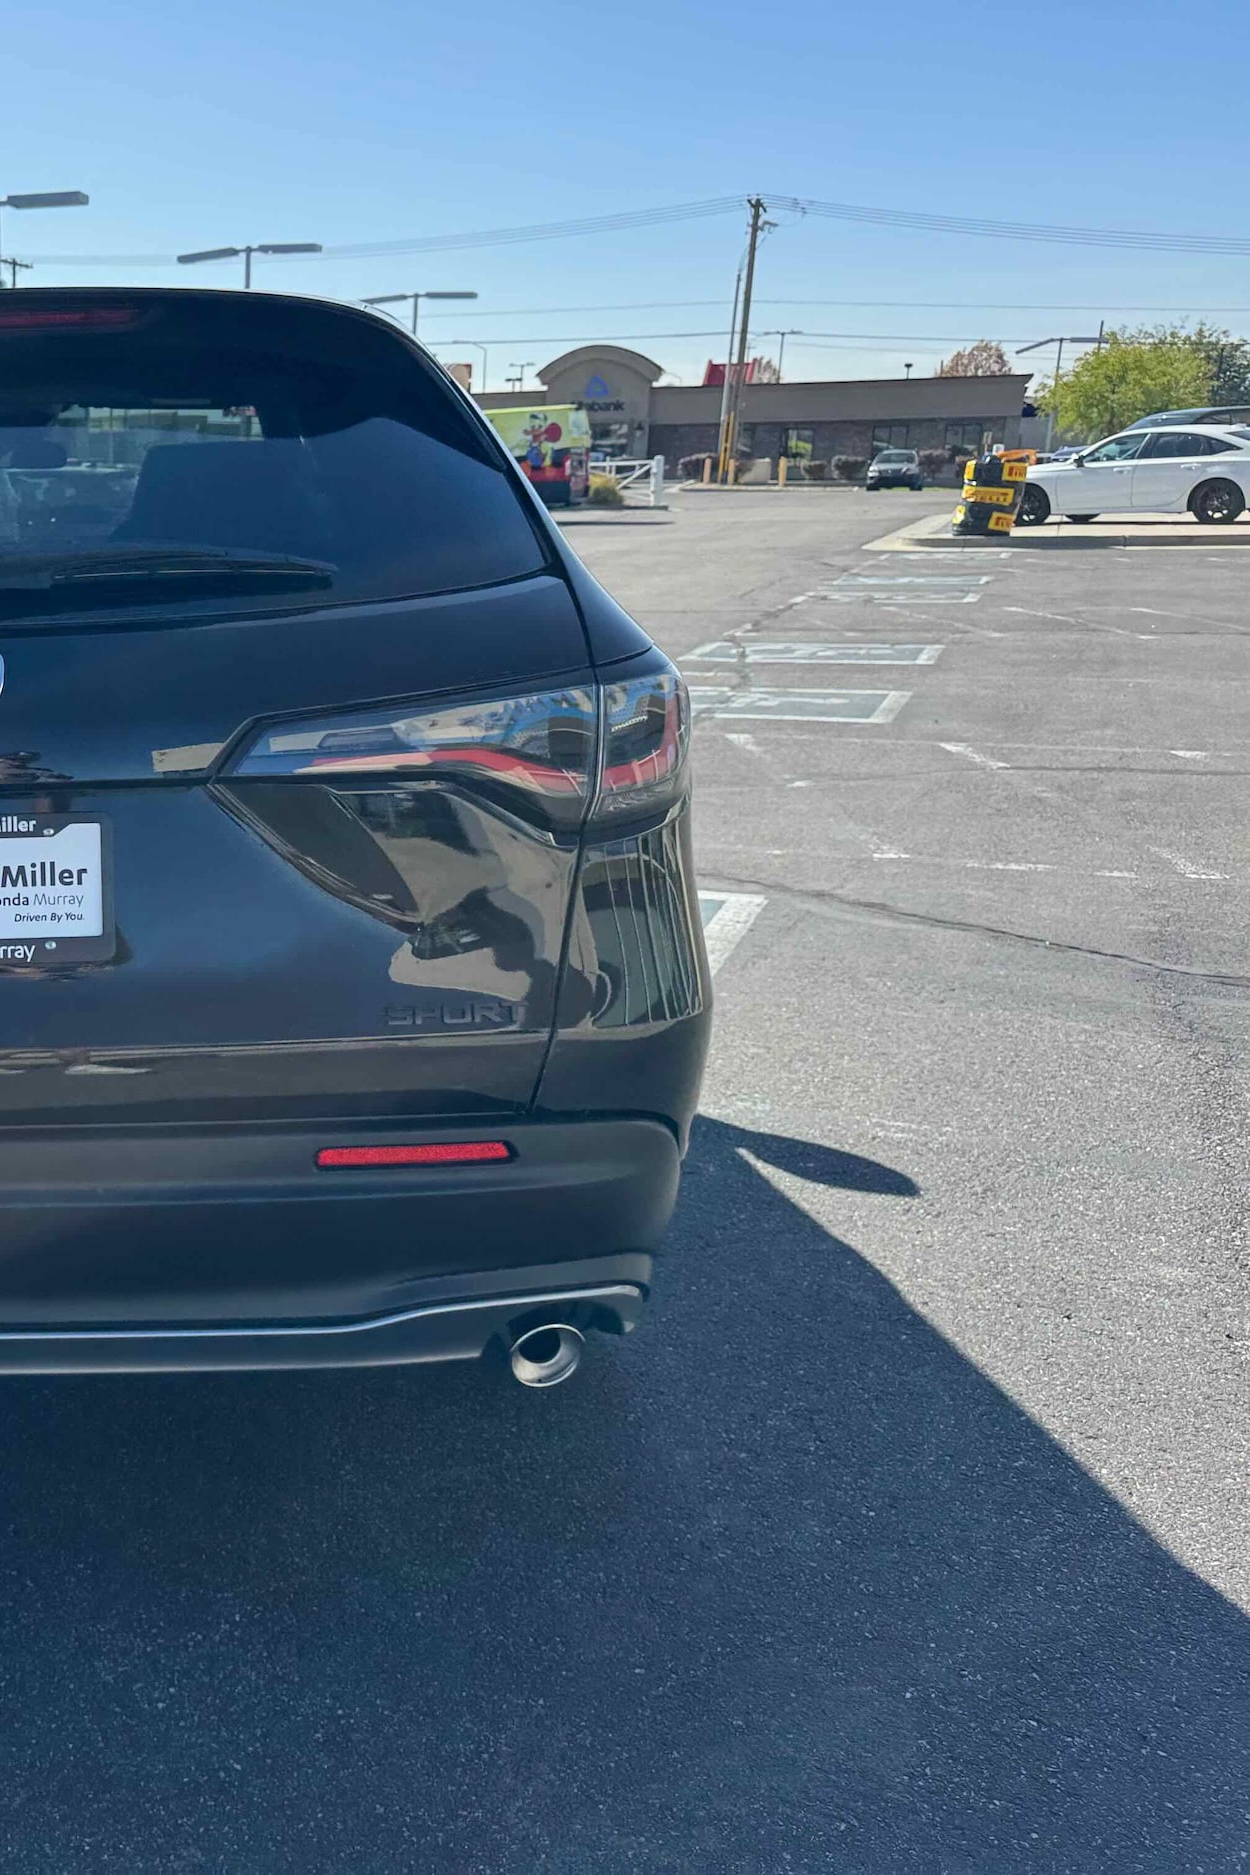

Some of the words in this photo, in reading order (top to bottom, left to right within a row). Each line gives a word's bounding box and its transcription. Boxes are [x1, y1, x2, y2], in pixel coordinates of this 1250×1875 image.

[1, 861, 88, 888] Miller
[33, 893, 85, 908] Murray
[14, 912, 48, 923] Driven
[50, 912, 63, 923] By
[384, 1001, 527, 1026] SPORT
